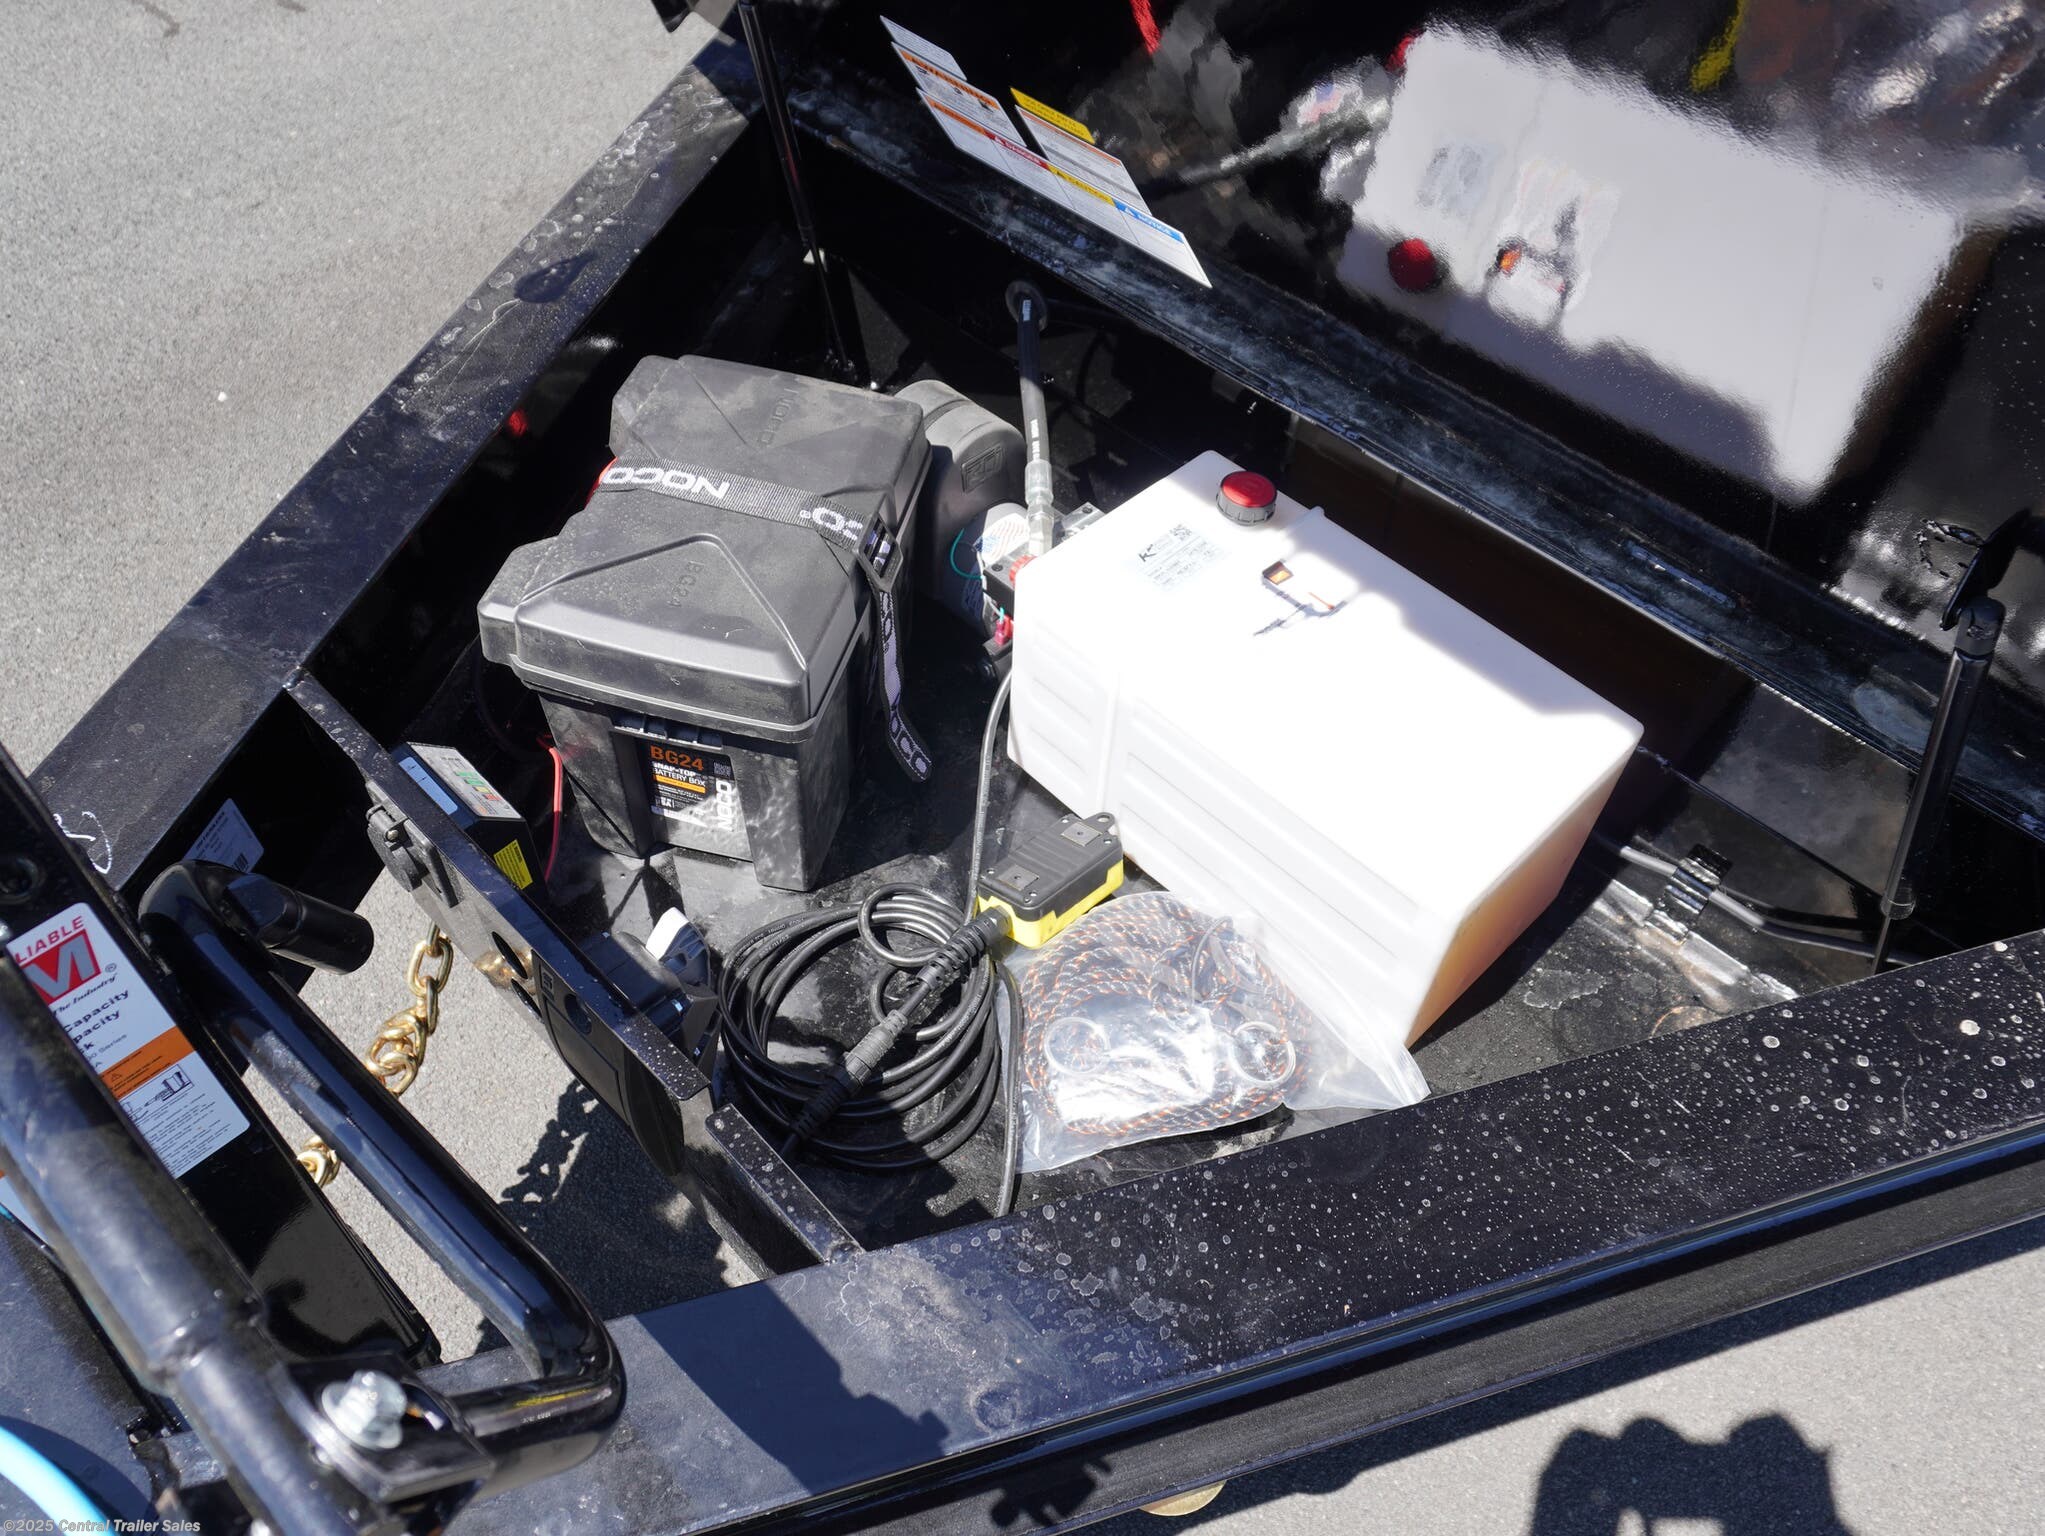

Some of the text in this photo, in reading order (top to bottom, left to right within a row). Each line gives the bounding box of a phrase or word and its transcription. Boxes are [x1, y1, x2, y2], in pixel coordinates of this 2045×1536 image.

[602, 467, 730, 499] NOCO
[650, 745, 704, 771] BG24
[653, 768, 688, 782] BATTERY
[688, 777, 706, 787] BOX
[715, 779, 734, 831] NOCO
[63, 990, 129, 1033] Capacity
